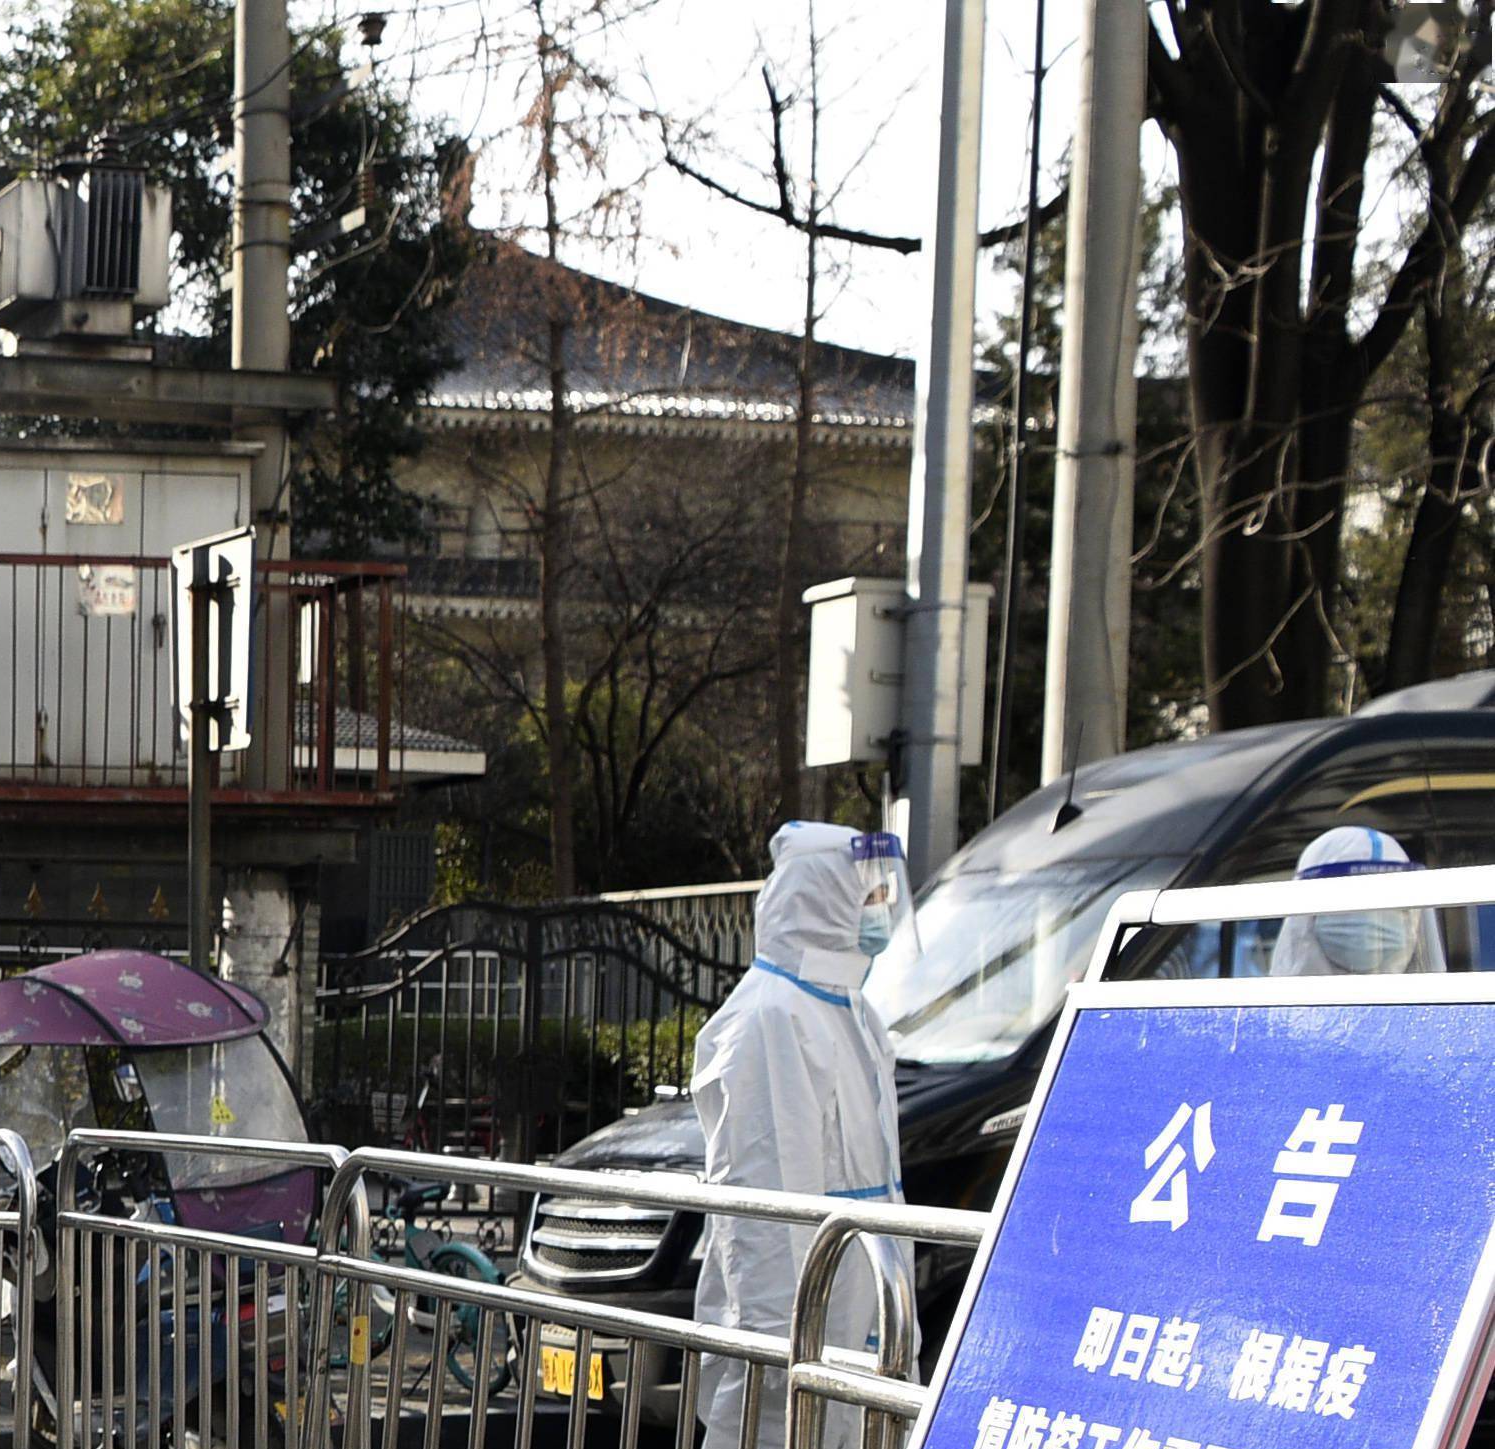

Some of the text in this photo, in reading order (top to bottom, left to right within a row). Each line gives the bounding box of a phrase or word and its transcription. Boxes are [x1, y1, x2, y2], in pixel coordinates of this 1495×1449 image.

[1129, 1101, 1365, 1247] 公告
[1072, 1306, 1377, 1421] 即日起，根据疫
